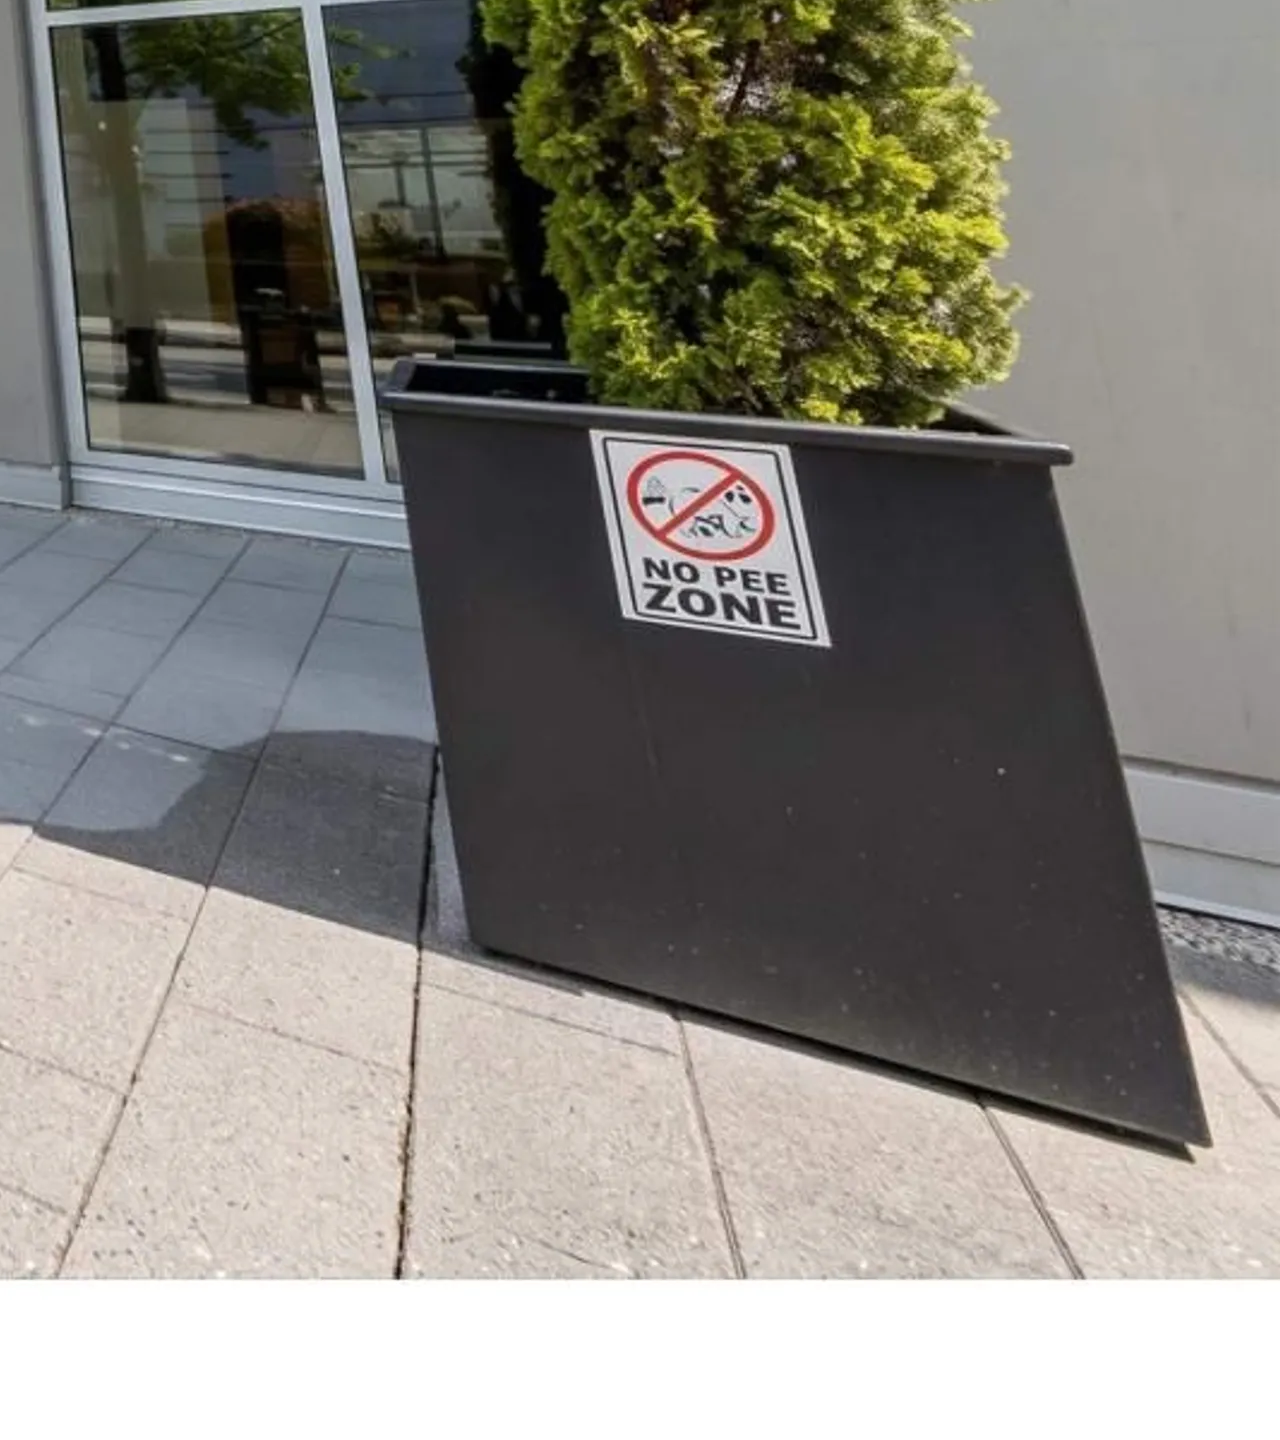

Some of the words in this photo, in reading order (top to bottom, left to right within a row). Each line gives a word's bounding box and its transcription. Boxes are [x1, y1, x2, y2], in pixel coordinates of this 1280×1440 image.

[642, 558, 700, 583] NO
[714, 566, 791, 596] PEE
[641, 583, 801, 630] ZONE
